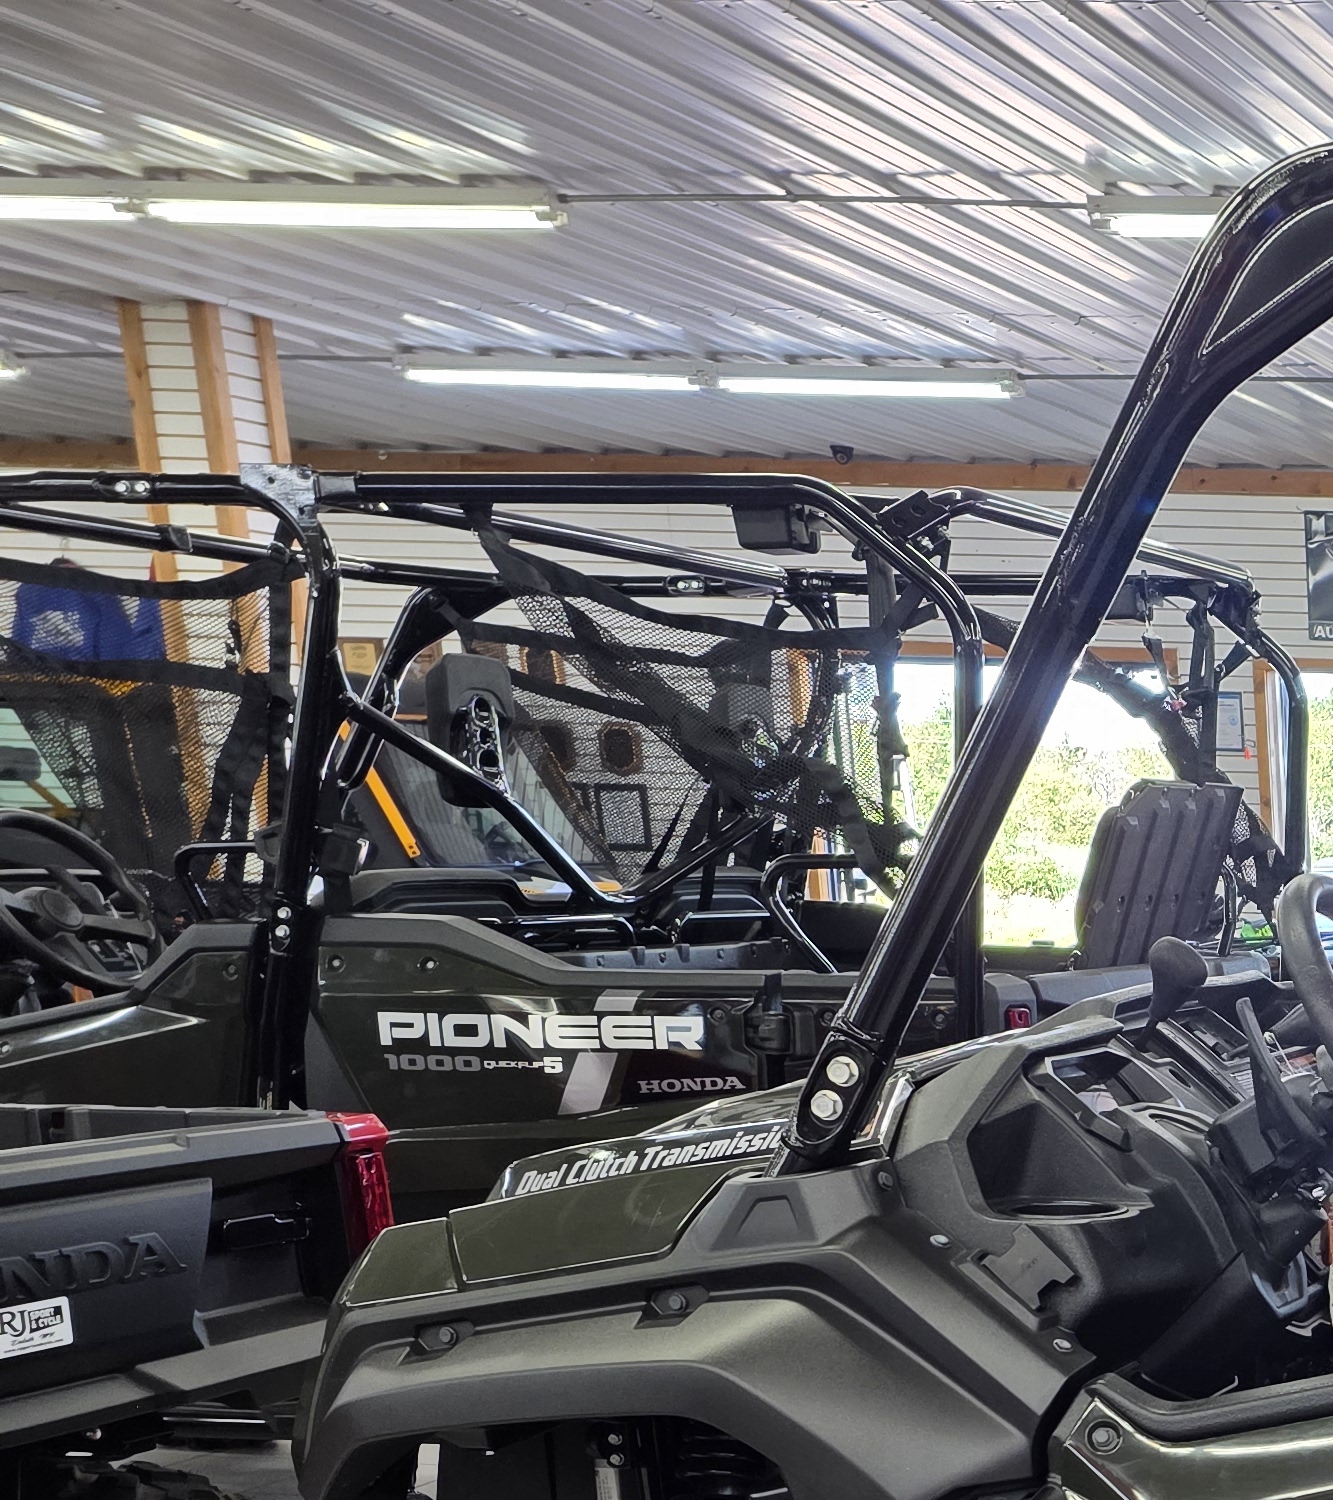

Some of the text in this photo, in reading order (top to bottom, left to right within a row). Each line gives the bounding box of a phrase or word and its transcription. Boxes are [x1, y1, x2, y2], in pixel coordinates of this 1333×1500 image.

[377, 1011, 705, 1050] PIONEER
[384, 1053, 481, 1072] 1000
[637, 1076, 746, 1095] HONDA
[515, 1163, 567, 1196] Dual
[566, 1150, 640, 1186] Clutch
